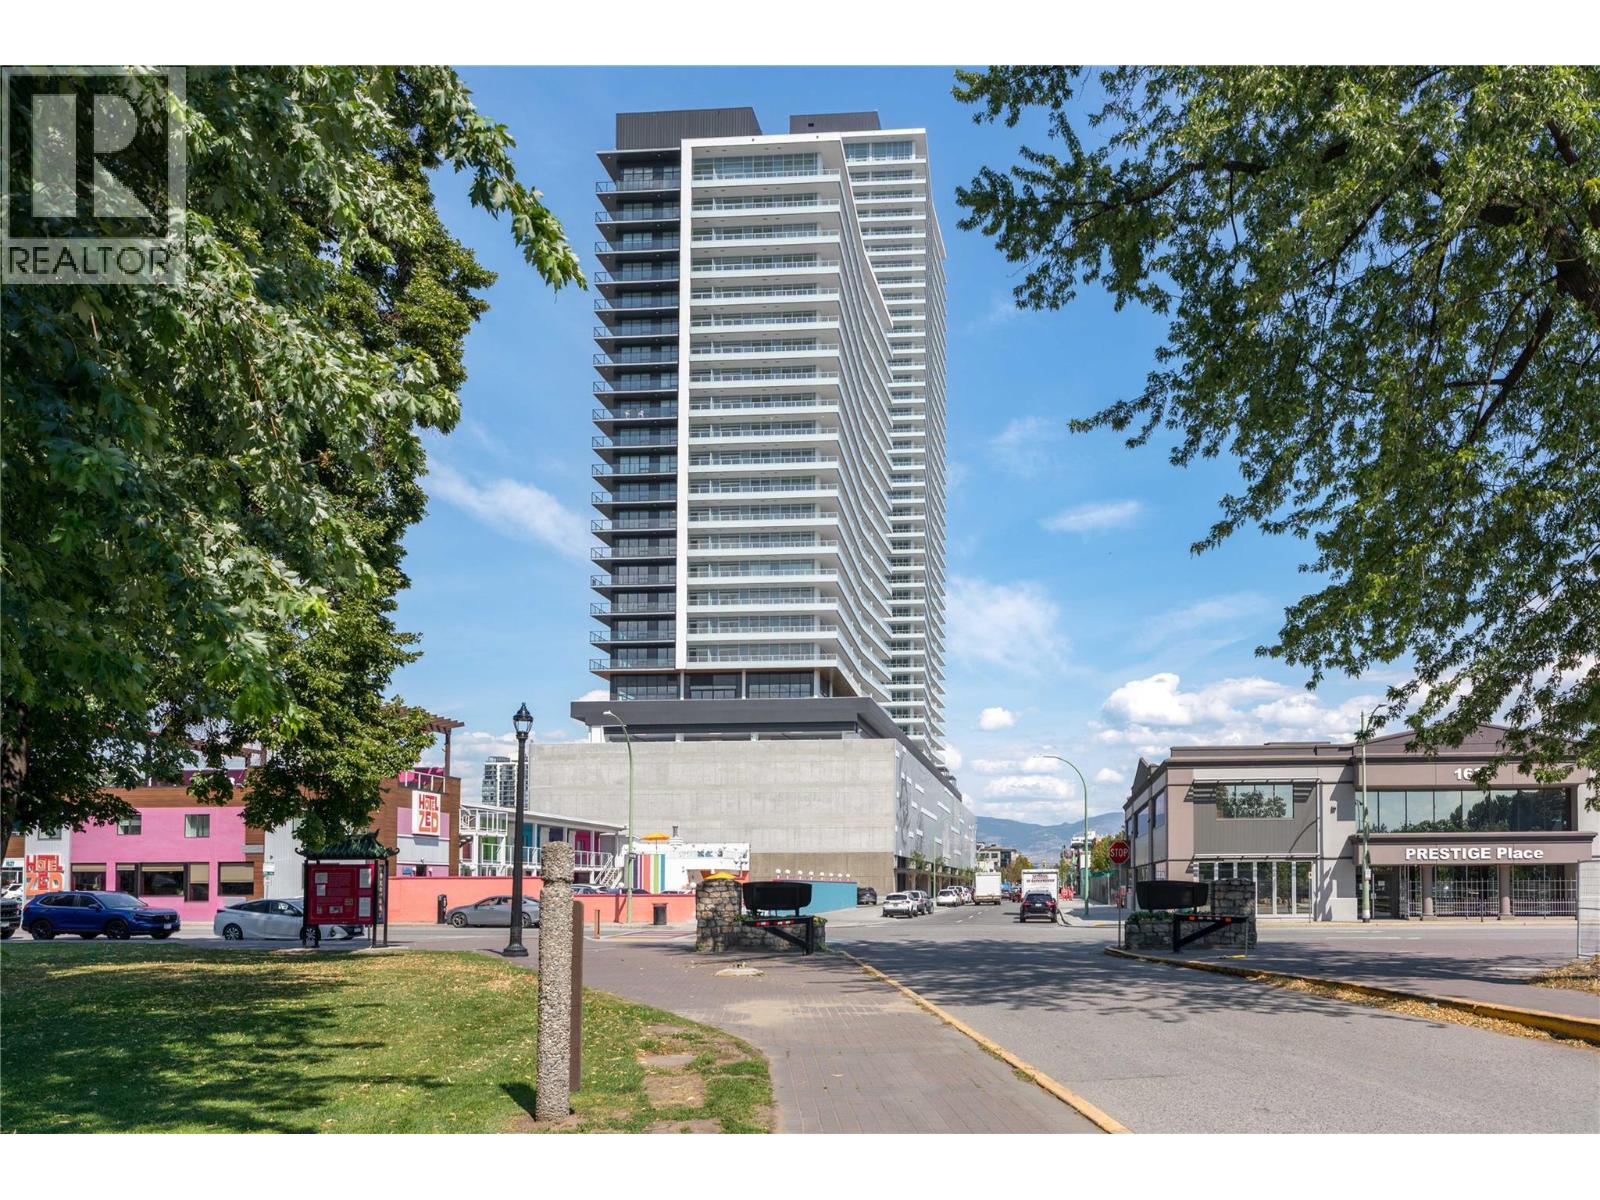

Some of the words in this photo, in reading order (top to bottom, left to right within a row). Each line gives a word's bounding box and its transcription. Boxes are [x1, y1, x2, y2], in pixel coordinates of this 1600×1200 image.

[418, 793, 439, 811] HOTEL
[418, 810, 439, 833] ZED
[1110, 848, 1129, 857] STOP
[1405, 847, 1491, 860] PRESTIGE
[1496, 847, 1544, 859] Place
[26, 854, 63, 873] HOTEL
[25, 871, 64, 897] ZED
